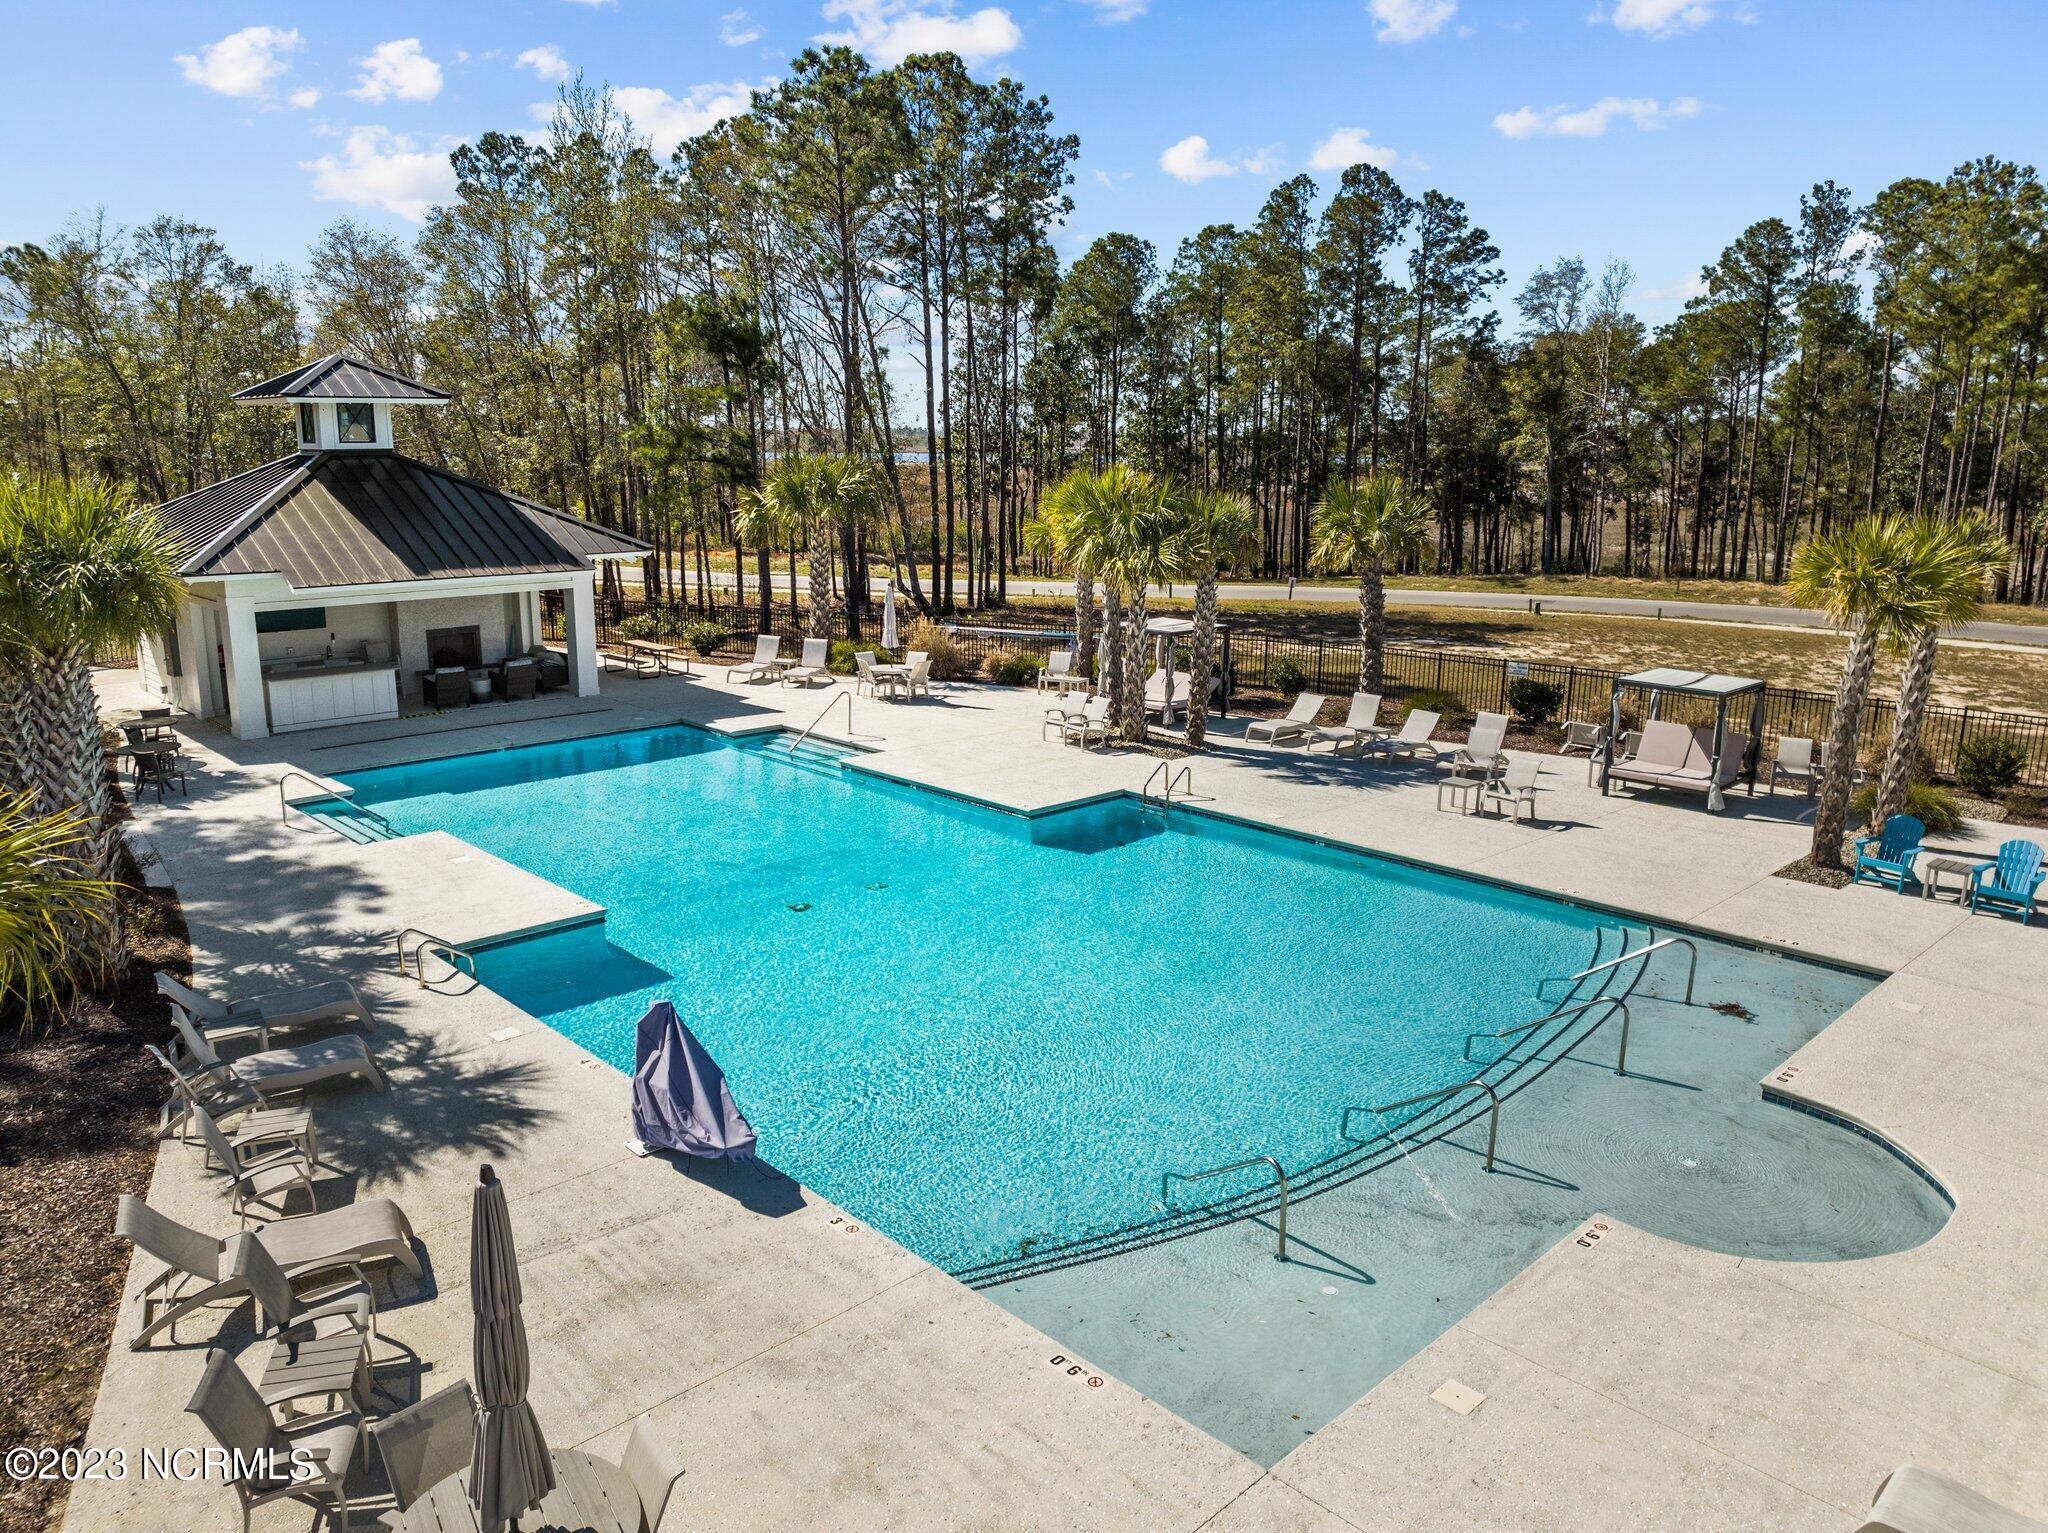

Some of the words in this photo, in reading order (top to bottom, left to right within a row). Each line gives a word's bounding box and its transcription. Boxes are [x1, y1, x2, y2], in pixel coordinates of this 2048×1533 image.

[830, 1217, 843, 1225] 3
[1576, 1239, 1592, 1248] 0
[1585, 1232, 1600, 1240] 6
[1050, 1355, 1066, 1366] 0
[1067, 1365, 1082, 1376] 6
